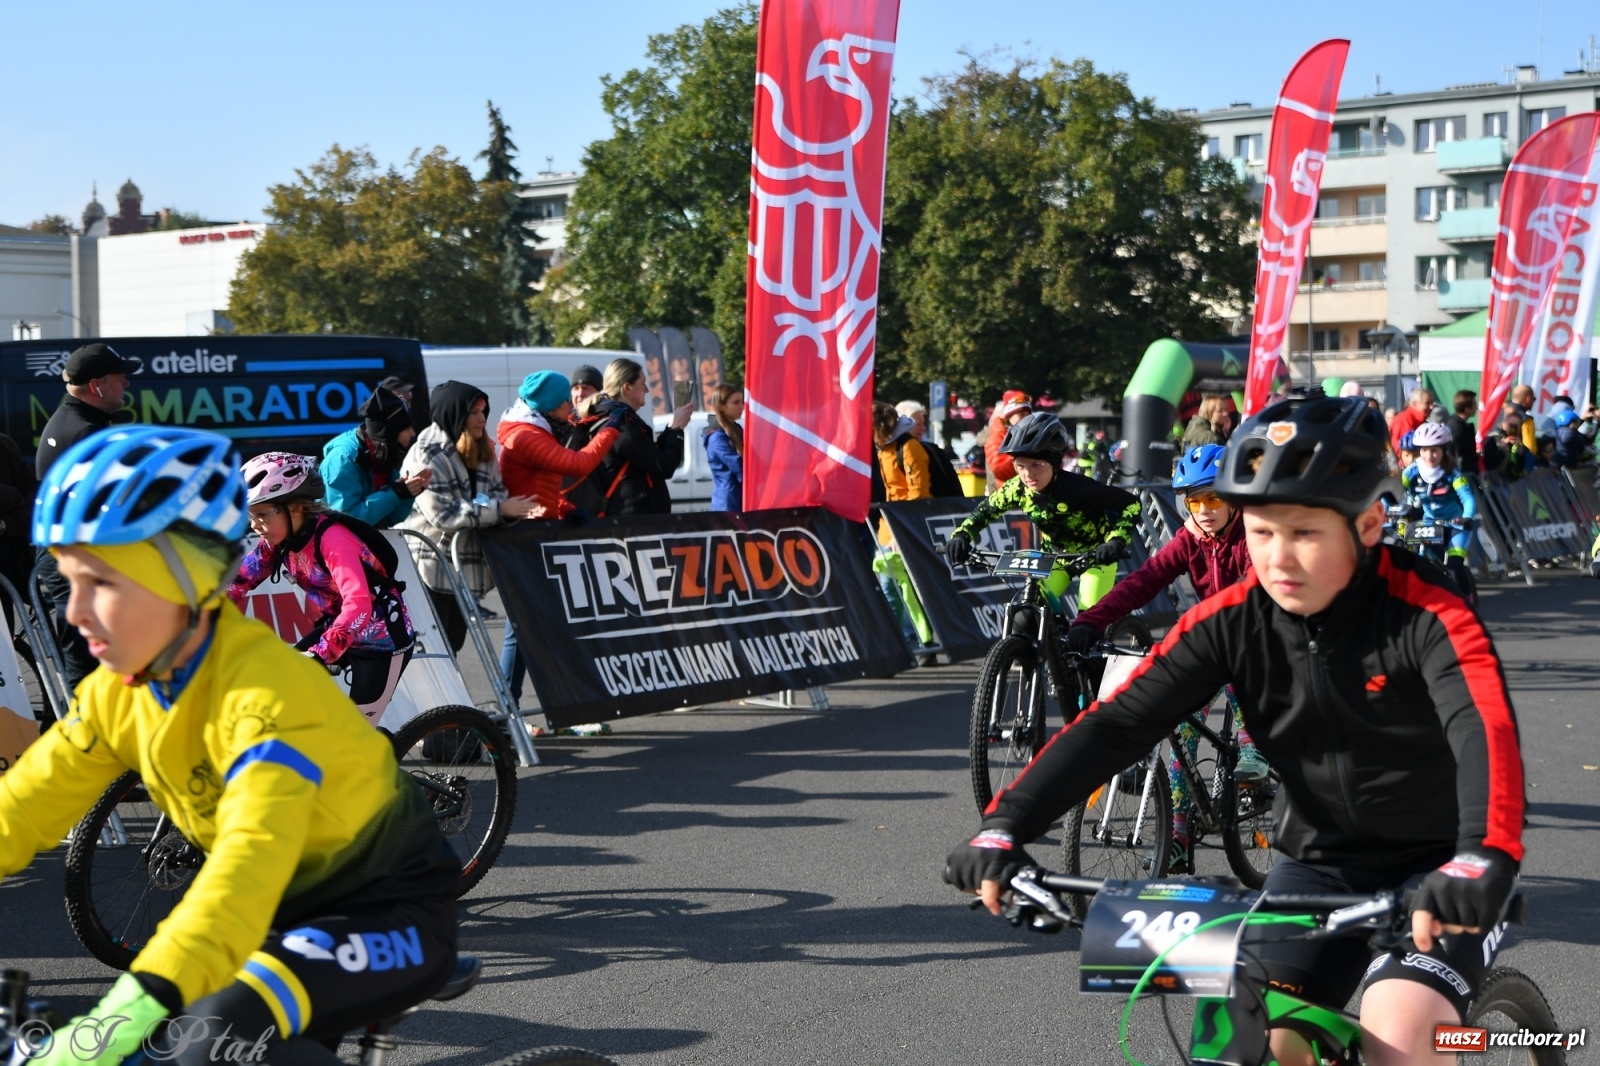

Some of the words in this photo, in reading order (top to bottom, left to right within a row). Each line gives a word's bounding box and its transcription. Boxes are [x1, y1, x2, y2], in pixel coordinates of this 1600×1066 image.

[151, 349, 237, 374] atelier
[1414, 526, 1436, 538] 232
[544, 529, 827, 619] TREZADO
[1009, 558, 1039, 569] 211
[594, 640, 741, 698] USZCZELNIAMY
[744, 626, 859, 677] NAJLEPSZYCH
[1115, 910, 1201, 949] 248
